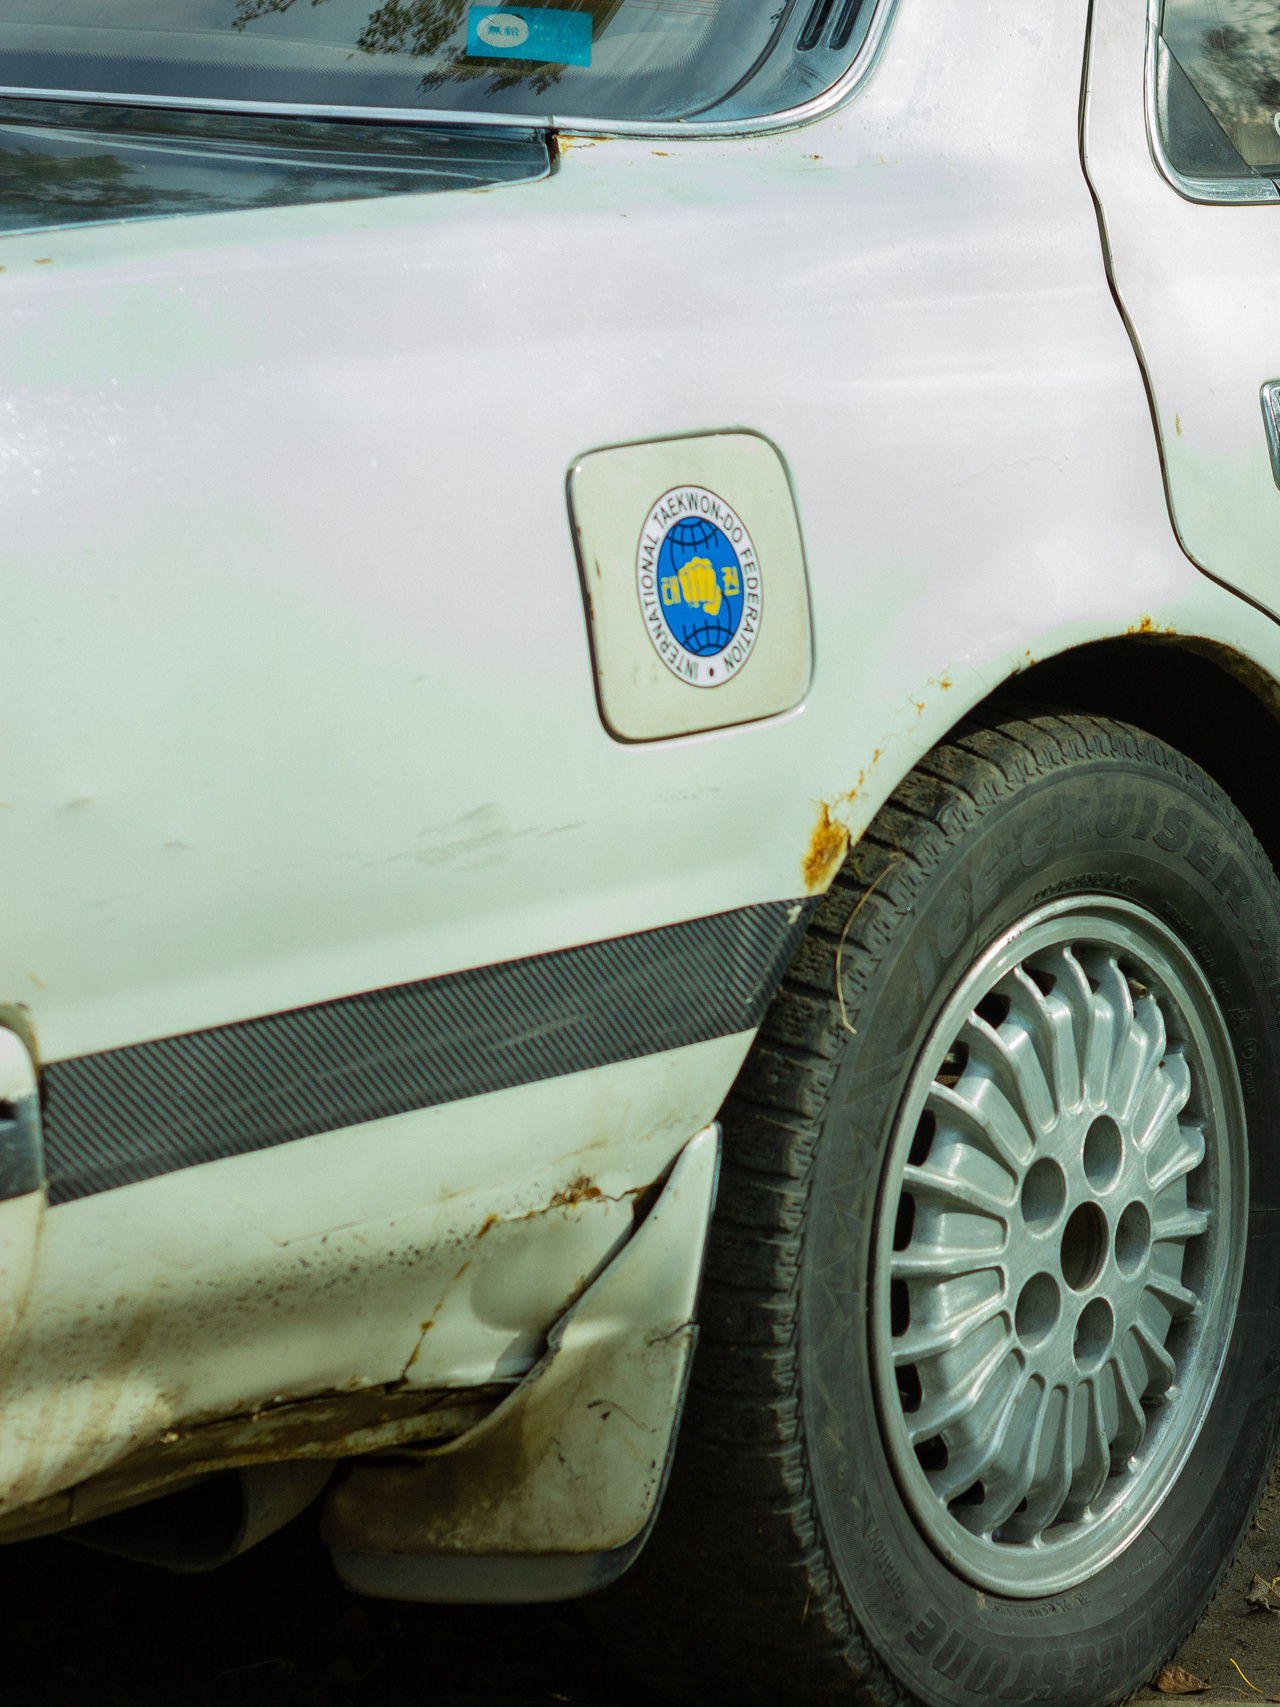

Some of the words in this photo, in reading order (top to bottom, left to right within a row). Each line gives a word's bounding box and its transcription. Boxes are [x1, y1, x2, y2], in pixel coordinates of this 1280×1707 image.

[653, 491, 743, 544] TAEKWON-DO
[640, 535, 699, 681] INTERNATIONAL
[722, 548, 759, 674] FEDERATION
[1020, 788, 1256, 919] CRUISER
